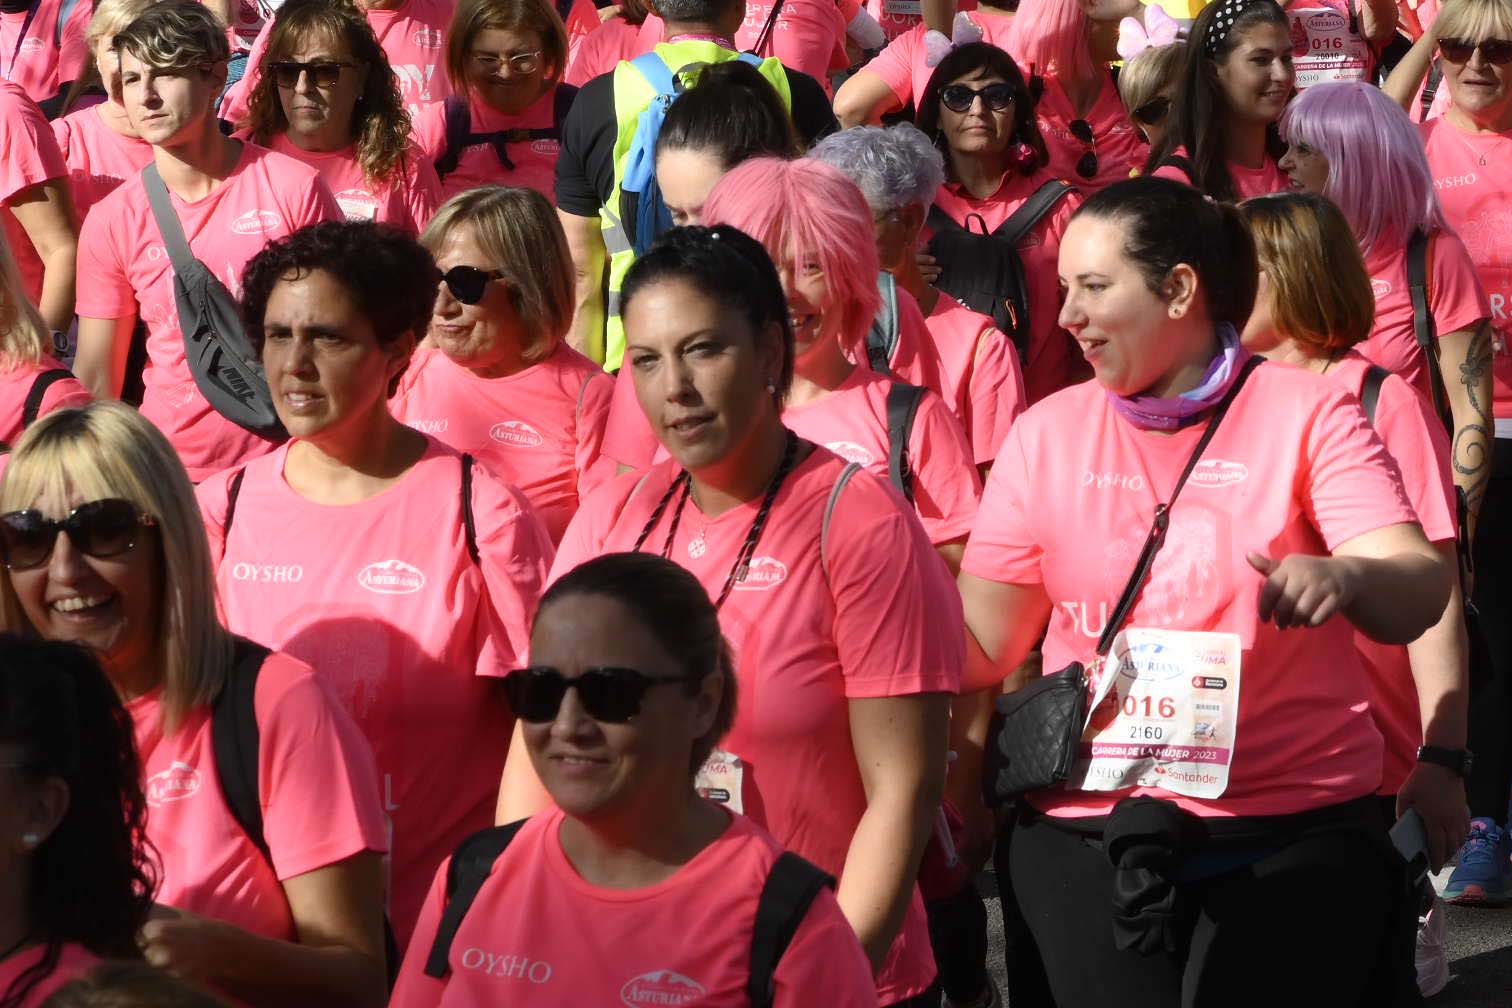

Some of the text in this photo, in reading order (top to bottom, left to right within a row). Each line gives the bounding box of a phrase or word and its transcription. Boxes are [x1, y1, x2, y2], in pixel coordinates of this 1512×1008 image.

[1311, 37, 1343, 50] 016
[232, 562, 304, 584] OYSHO
[1061, 600, 1107, 639] TU
[1122, 695, 1177, 719] 016
[1129, 726, 1162, 740] 2160
[1127, 747, 1139, 756] DE
[1140, 747, 1153, 756] LA
[1155, 748, 1191, 758] MUJER
[1192, 750, 1217, 760] 2023
[1166, 766, 1218, 784] Santander
[462, 947, 553, 984] OYSHO
